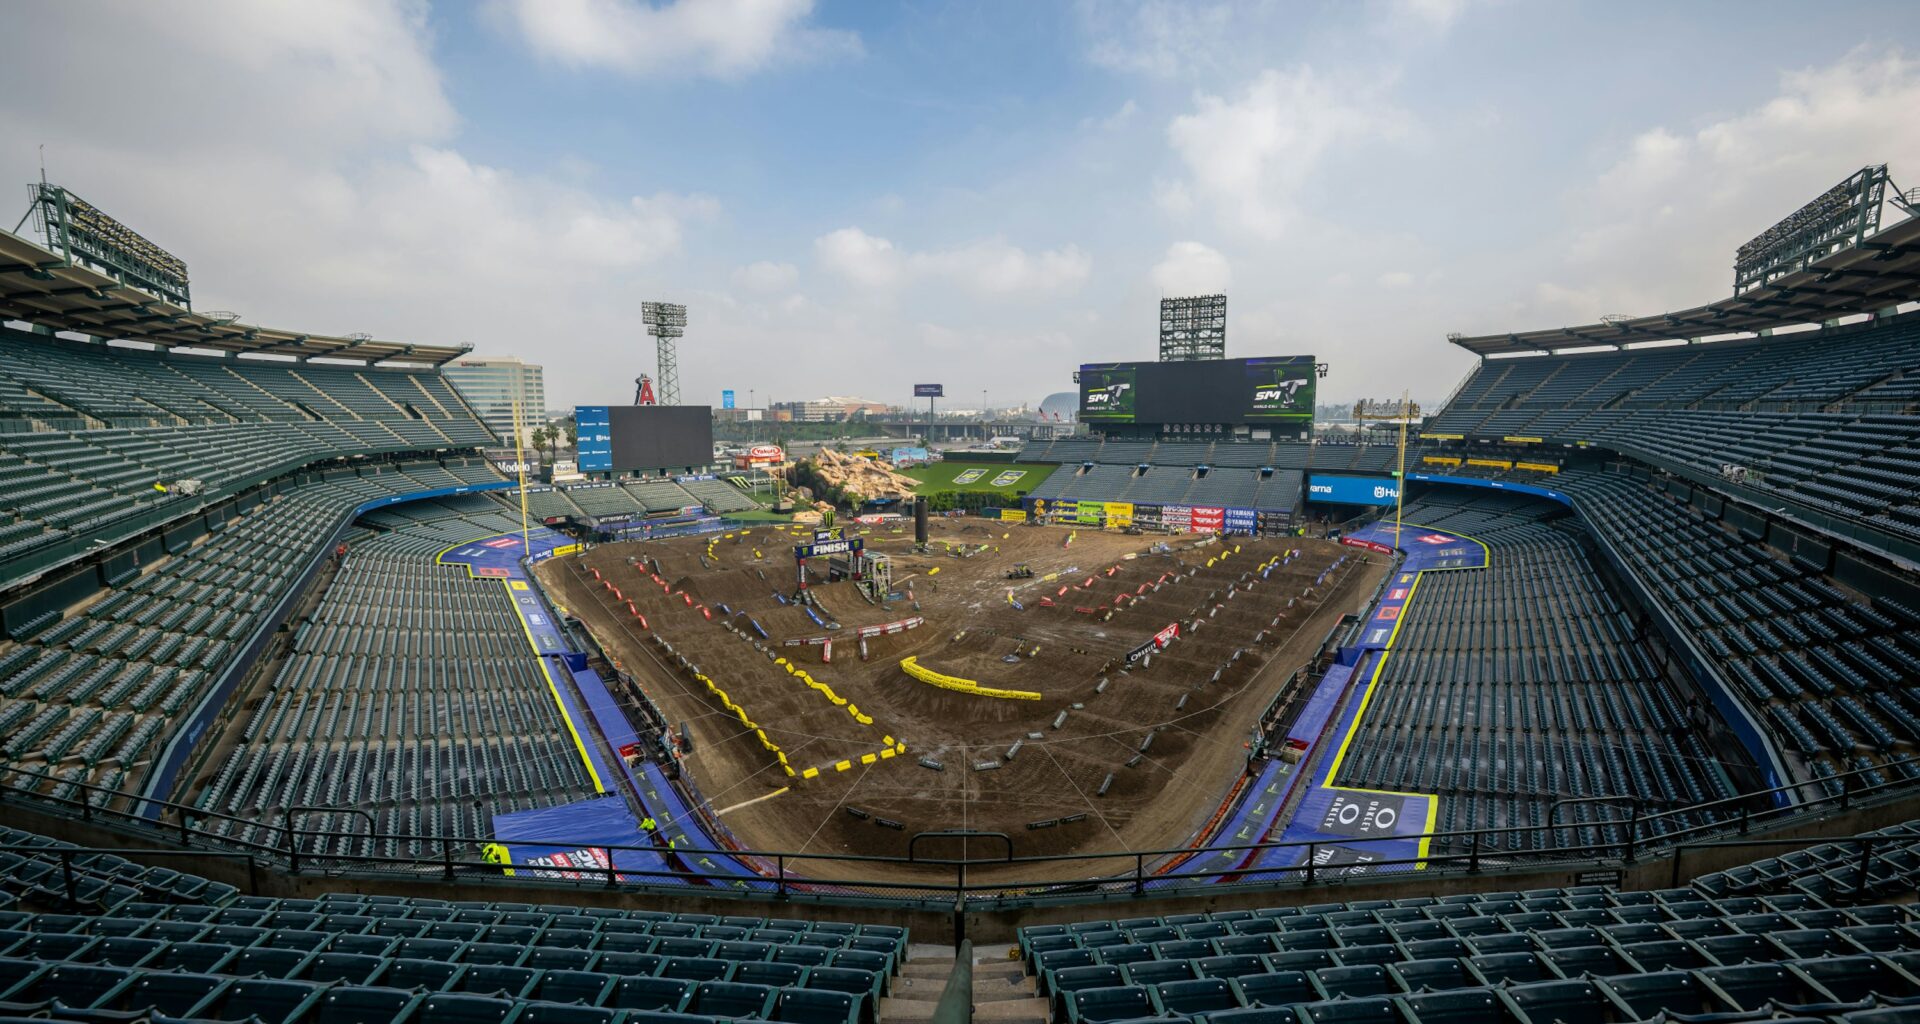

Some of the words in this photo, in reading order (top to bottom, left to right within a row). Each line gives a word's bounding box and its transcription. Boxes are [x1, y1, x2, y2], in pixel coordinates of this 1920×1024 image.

[812, 541, 850, 555] FINISH
[1324, 797, 1344, 828] OAKLEY
[1360, 801, 1379, 832] OAKLEY
